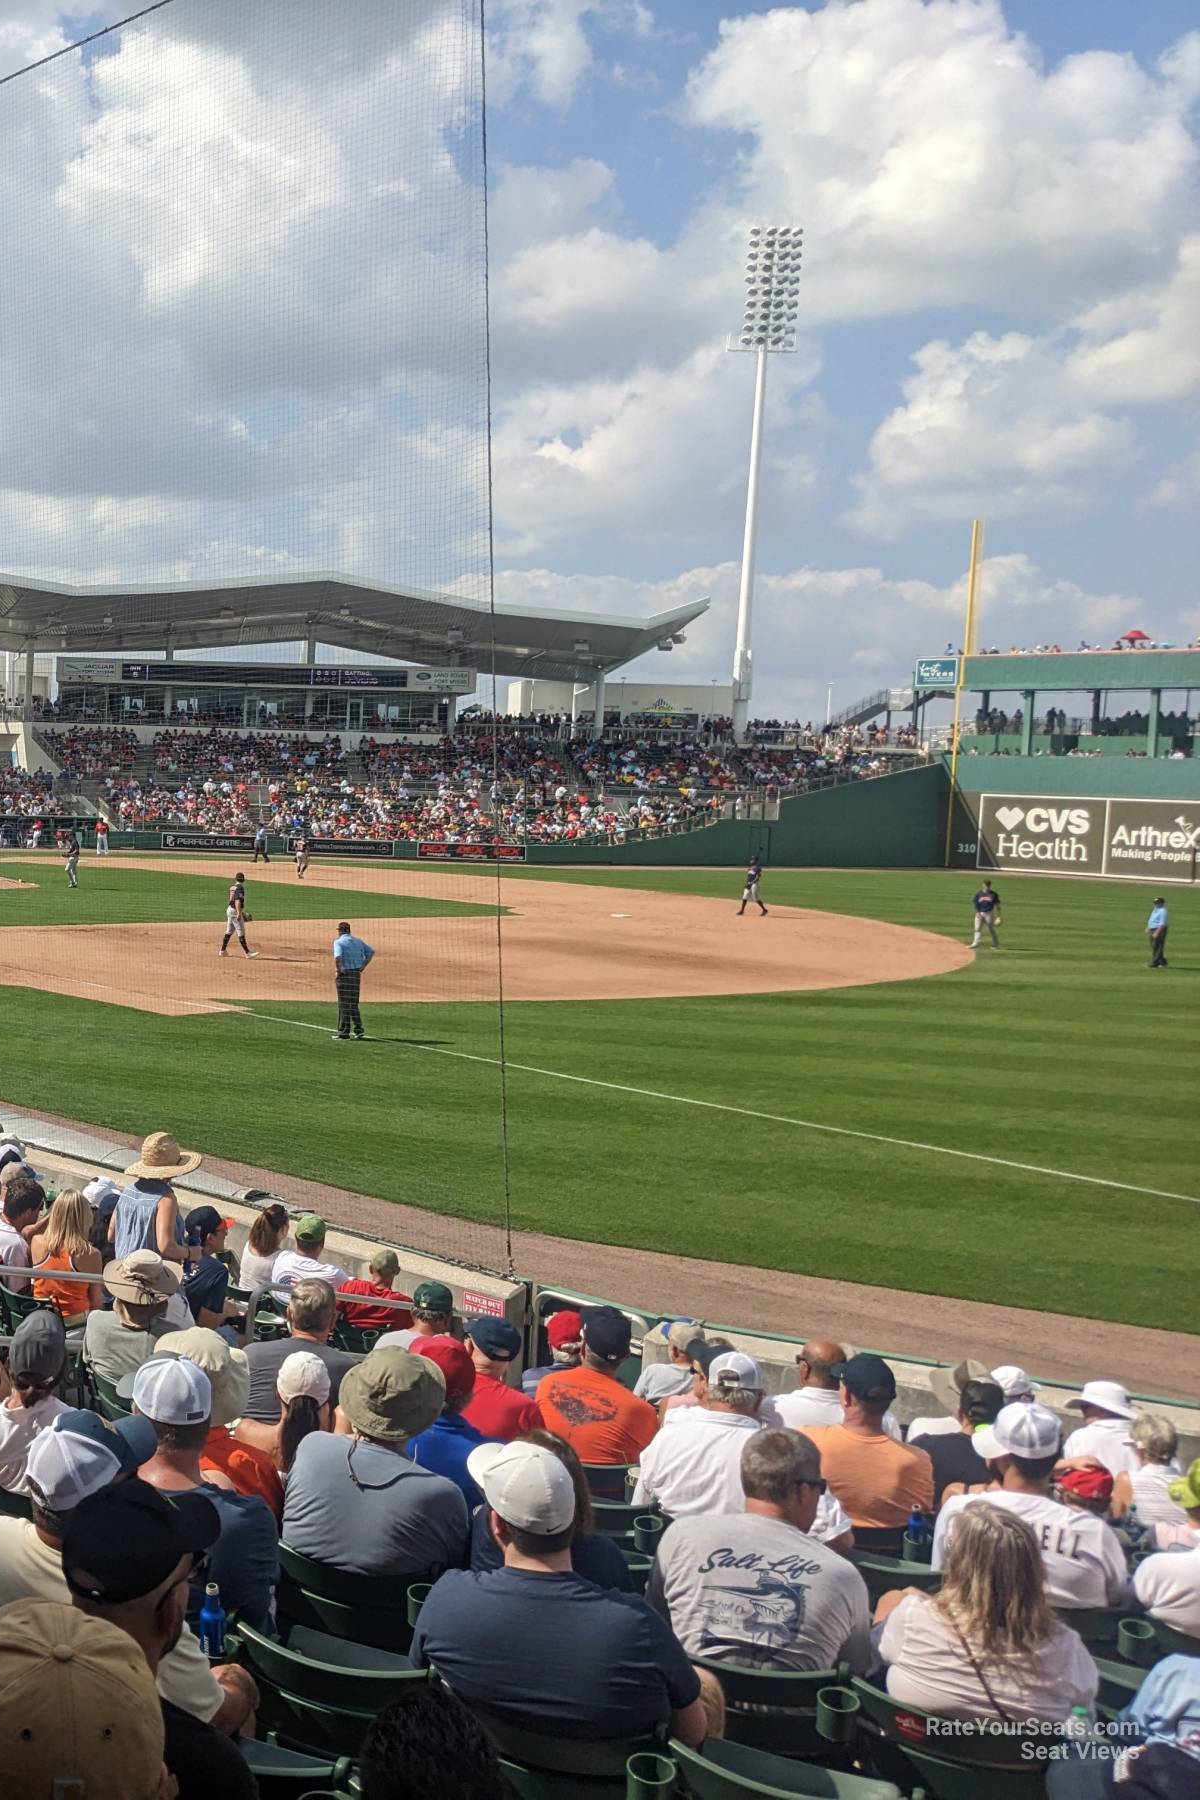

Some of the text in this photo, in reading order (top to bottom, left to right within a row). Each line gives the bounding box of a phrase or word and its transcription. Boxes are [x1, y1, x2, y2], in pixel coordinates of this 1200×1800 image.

[1026, 807, 1090, 835] CVS
[177, 838, 214, 846] PERFECT
[1112, 825, 1200, 849] Arthrex
[957, 843, 976, 854] 310
[995, 834, 1088, 862] Health
[1112, 848, 1152, 861] Making
[1154, 850, 1193, 863] People
[465, 1294, 487, 1306] WATCH
[487, 1300, 501, 1310] OUT
[698, 1548, 822, 1580] Salt Life
